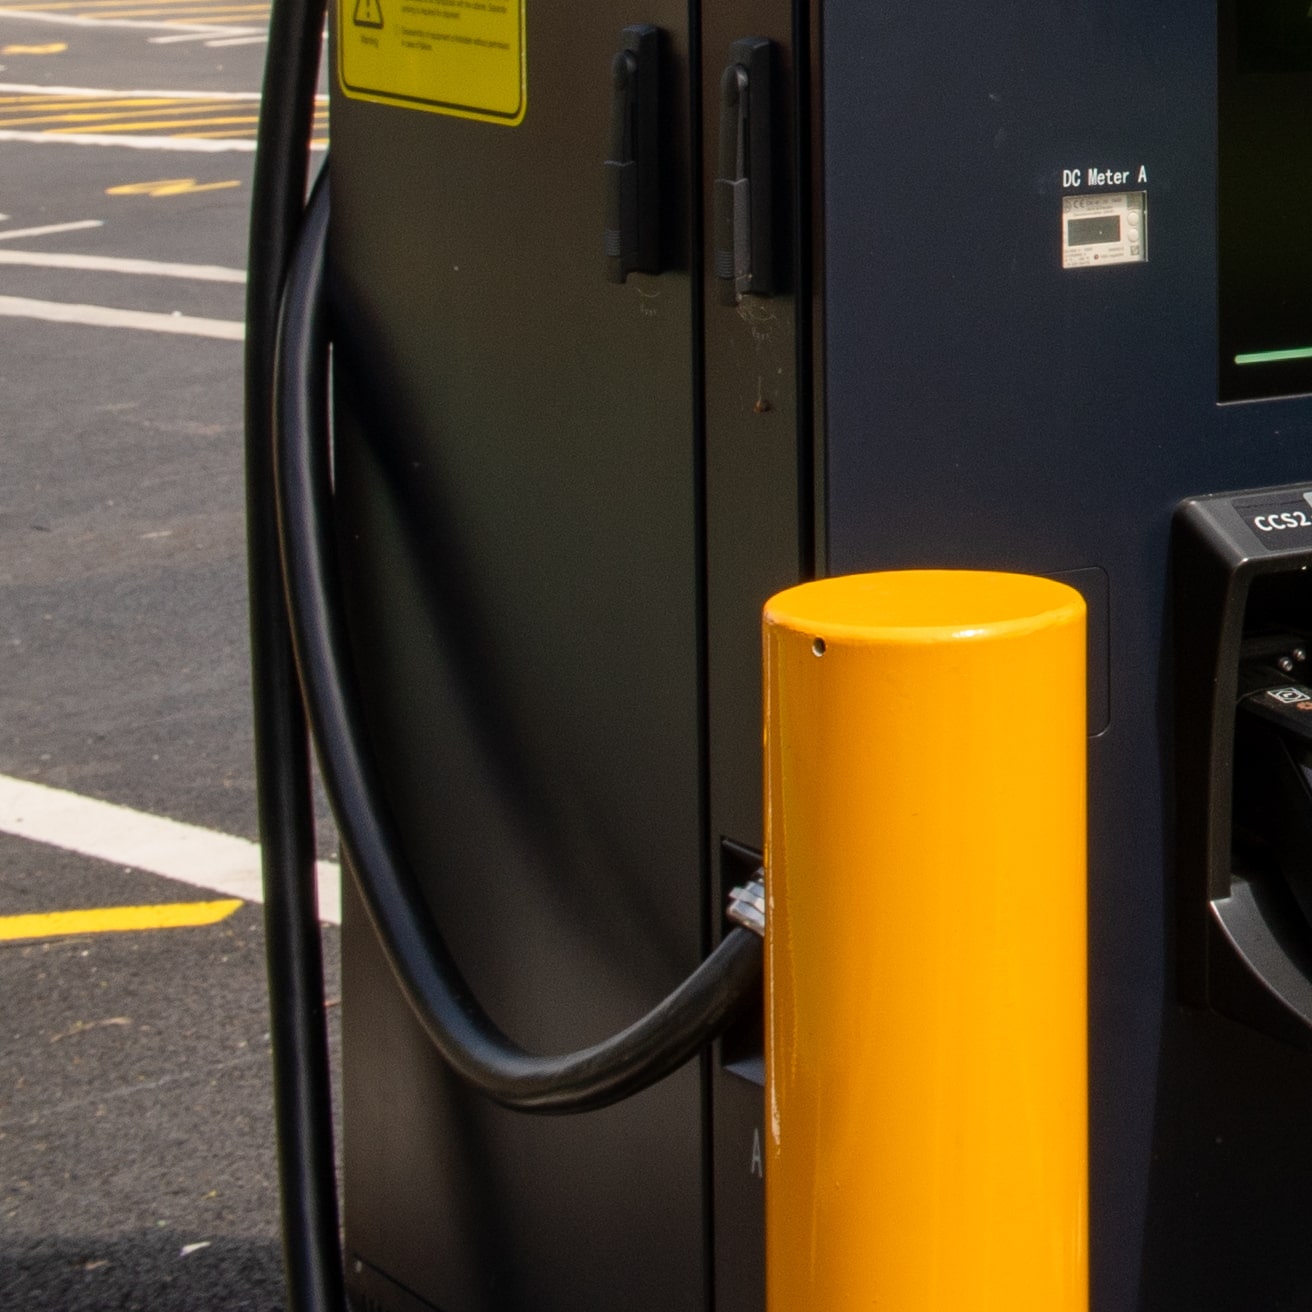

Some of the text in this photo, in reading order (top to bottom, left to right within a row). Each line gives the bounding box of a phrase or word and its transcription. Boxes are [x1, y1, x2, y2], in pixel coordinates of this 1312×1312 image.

[1062, 165, 1147, 188] DC Meter A
[1253, 510, 1312, 533] CCS2
[751, 1127, 763, 1178] A
